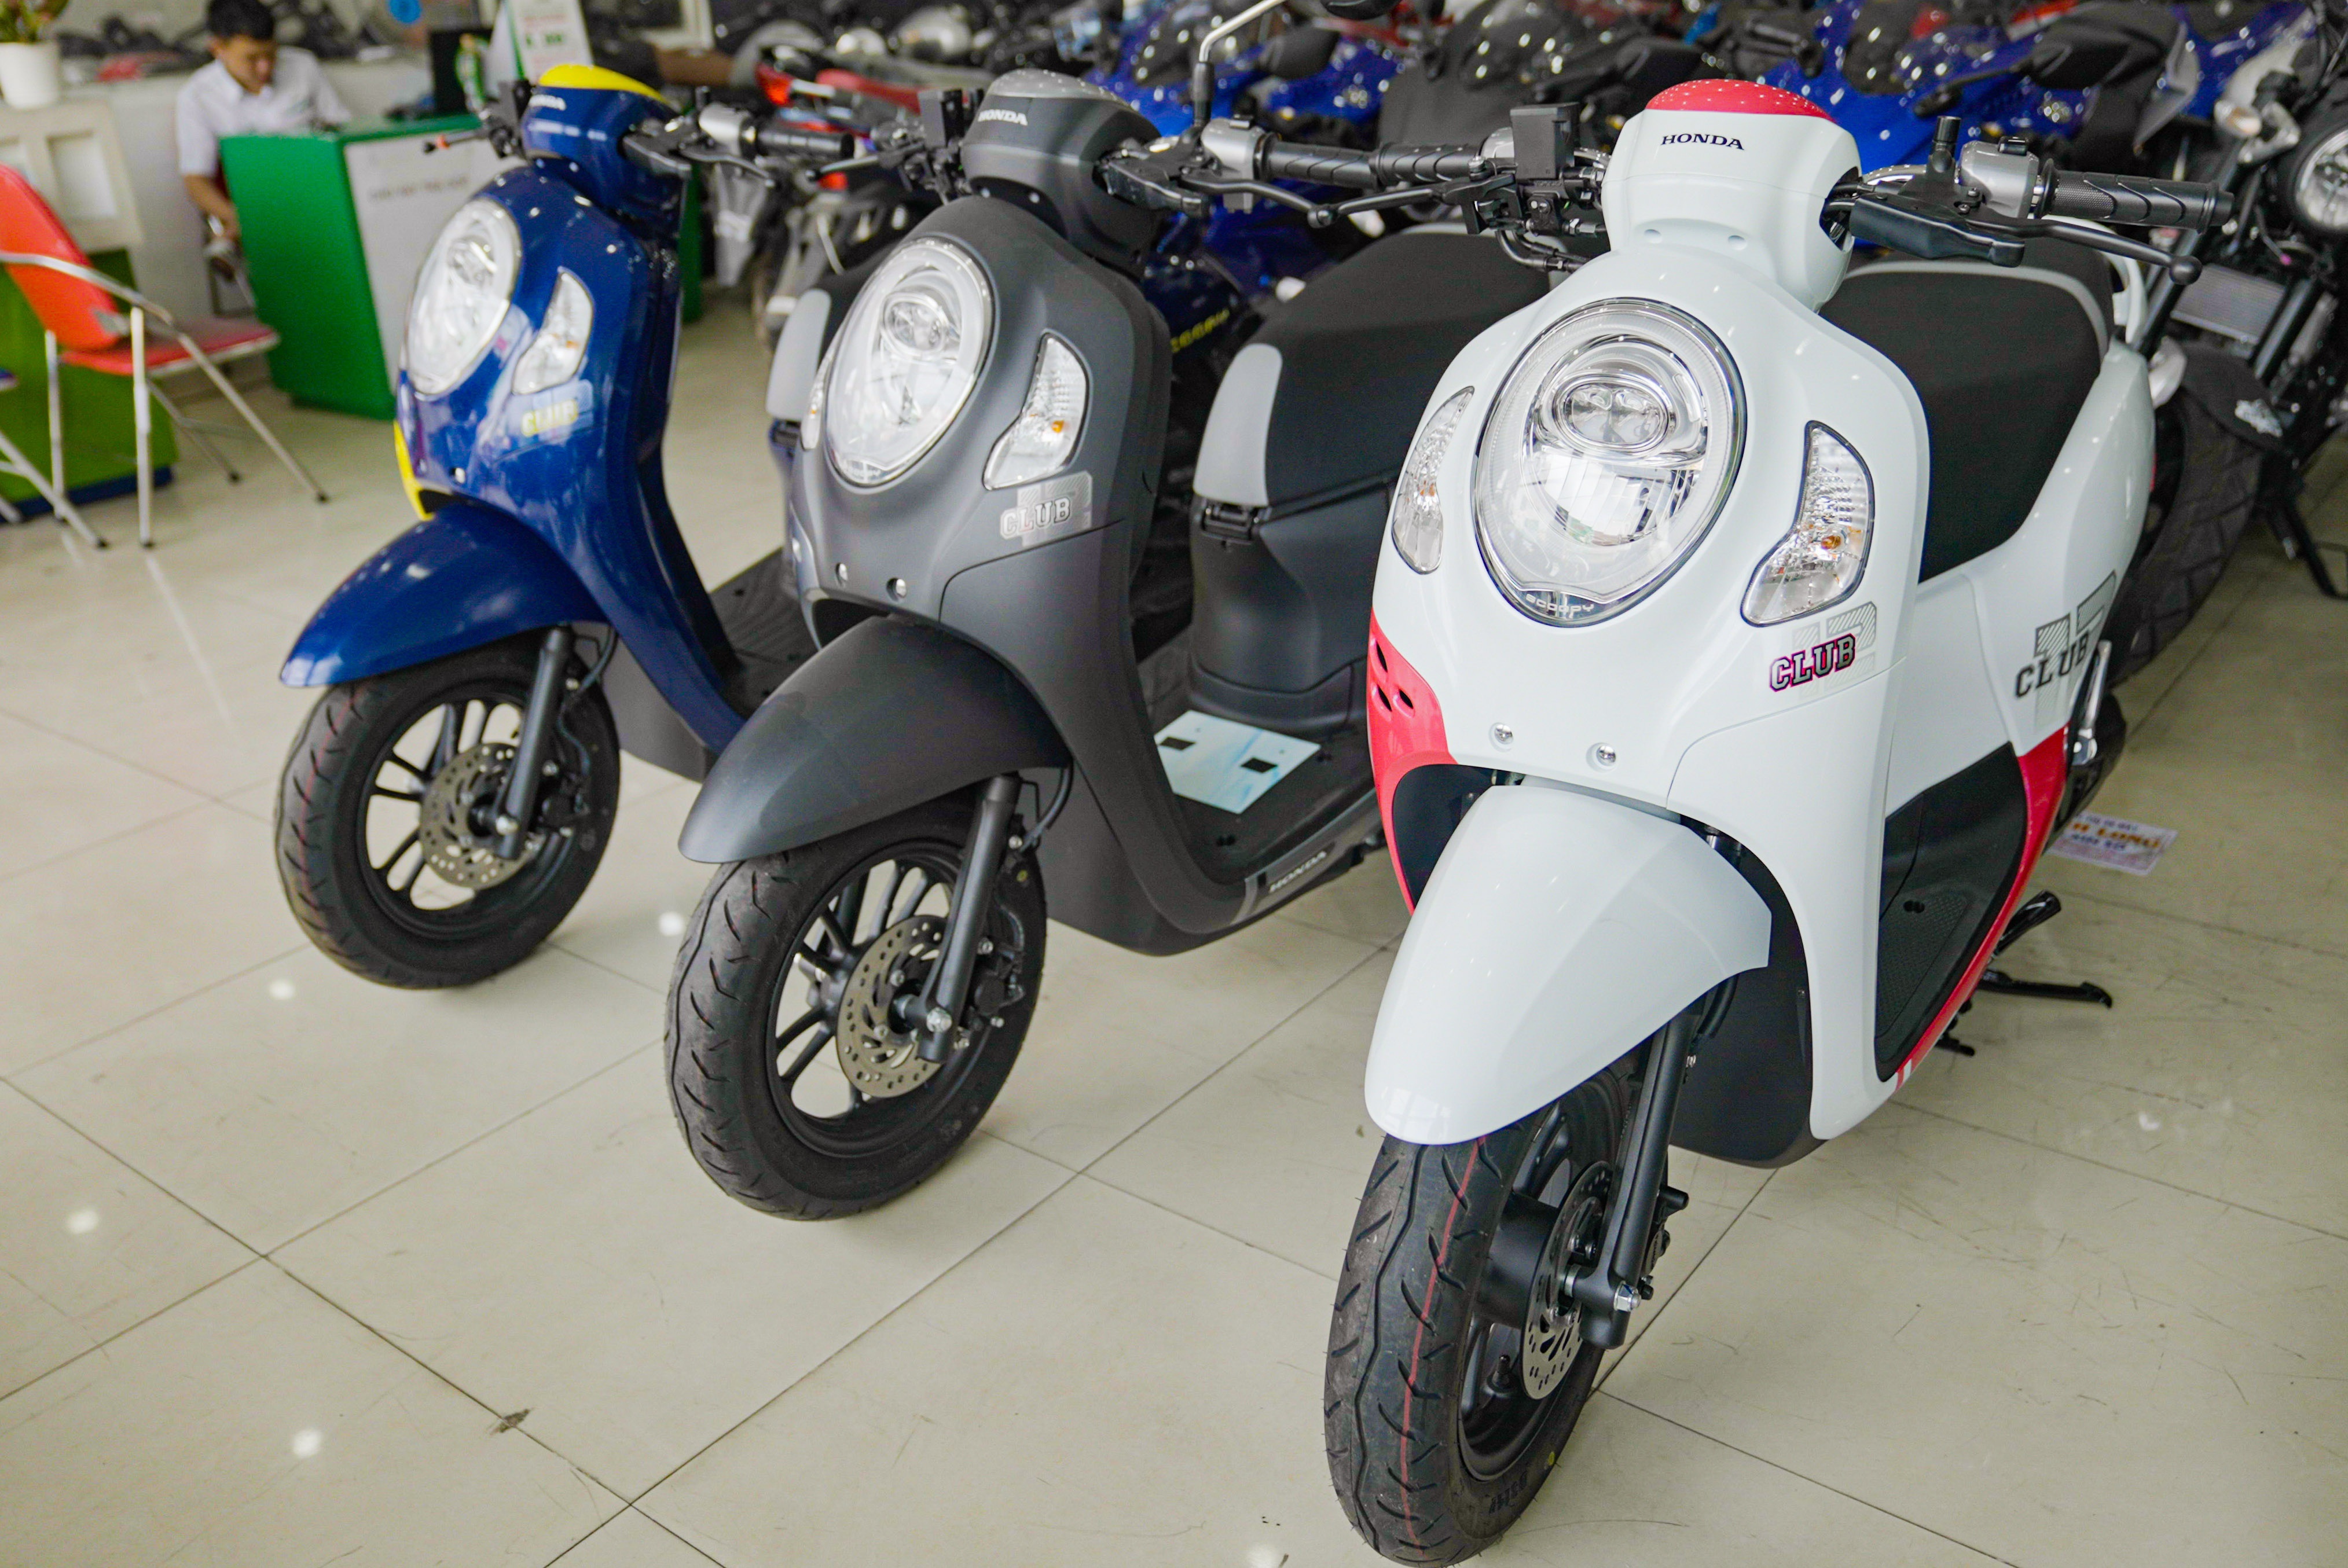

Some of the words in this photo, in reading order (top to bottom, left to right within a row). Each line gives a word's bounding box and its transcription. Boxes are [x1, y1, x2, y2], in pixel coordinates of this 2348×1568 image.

[977, 108, 1028, 126] HONDA
[1660, 133, 1745, 150] HONDA
[1001, 496, 1071, 539] CLUB
[1525, 593, 1595, 620] SCOOPY
[1769, 633, 1856, 692] CLUB
[2015, 631, 2090, 699] CLUB
